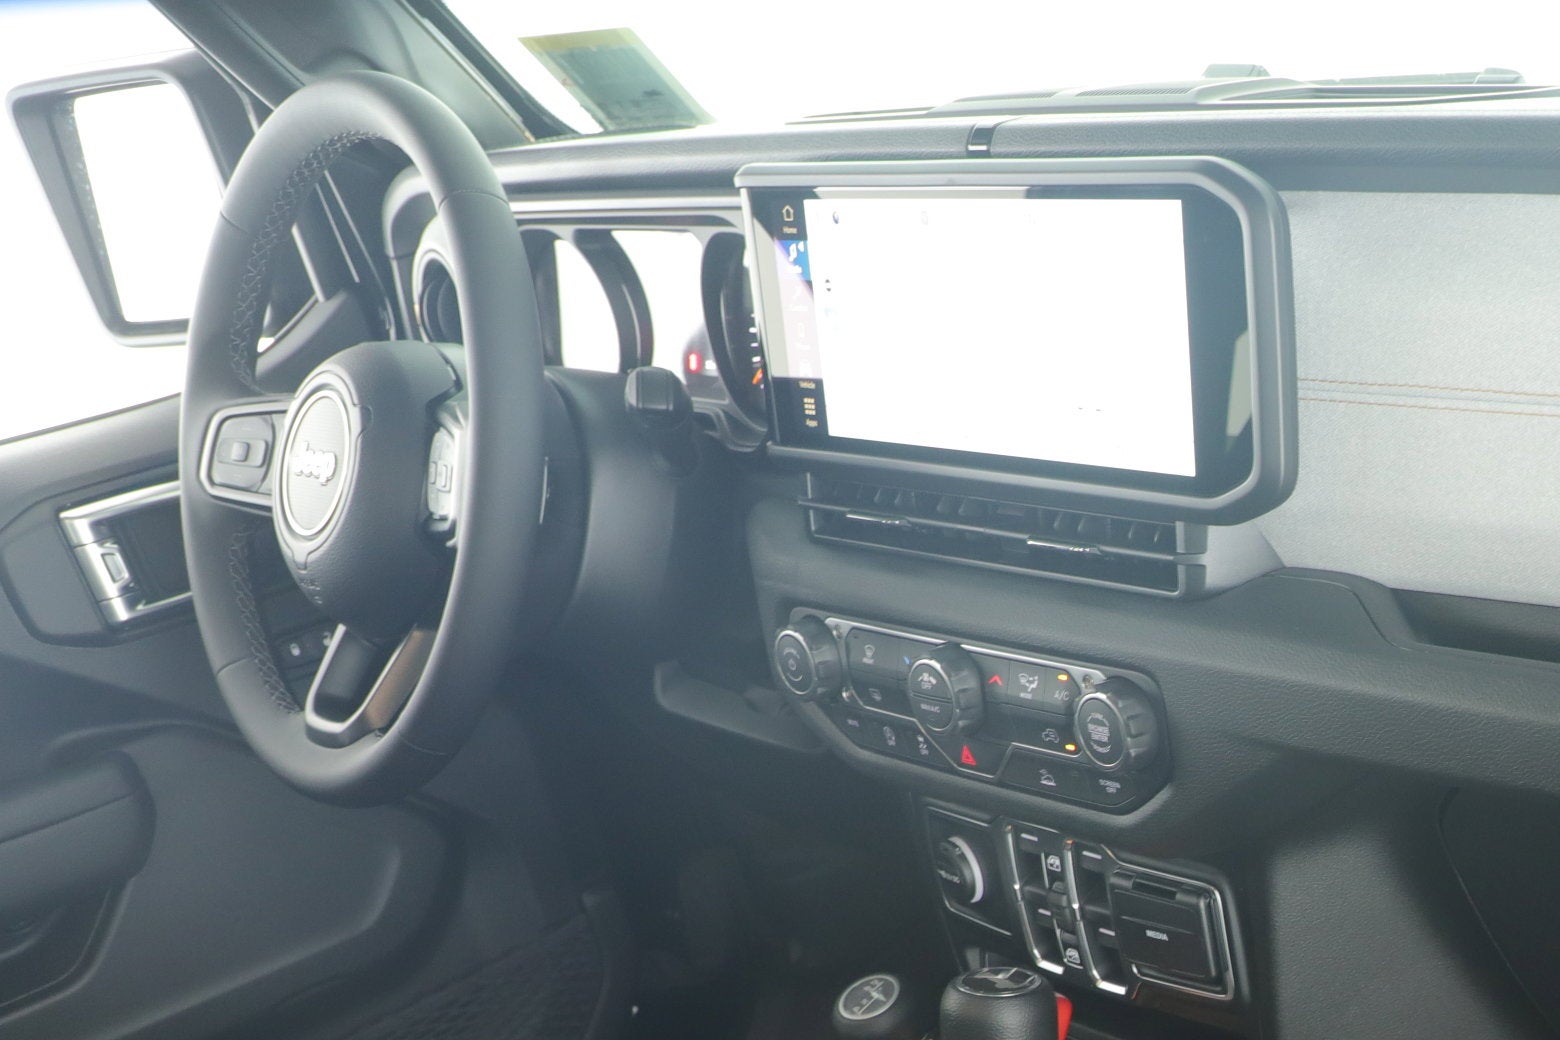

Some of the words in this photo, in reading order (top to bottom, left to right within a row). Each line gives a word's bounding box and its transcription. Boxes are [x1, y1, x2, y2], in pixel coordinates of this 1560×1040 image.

[293, 440, 337, 486] Jeep
[1054, 689, 1070, 701] A/C
[1145, 929, 1169, 942] MEDIA
